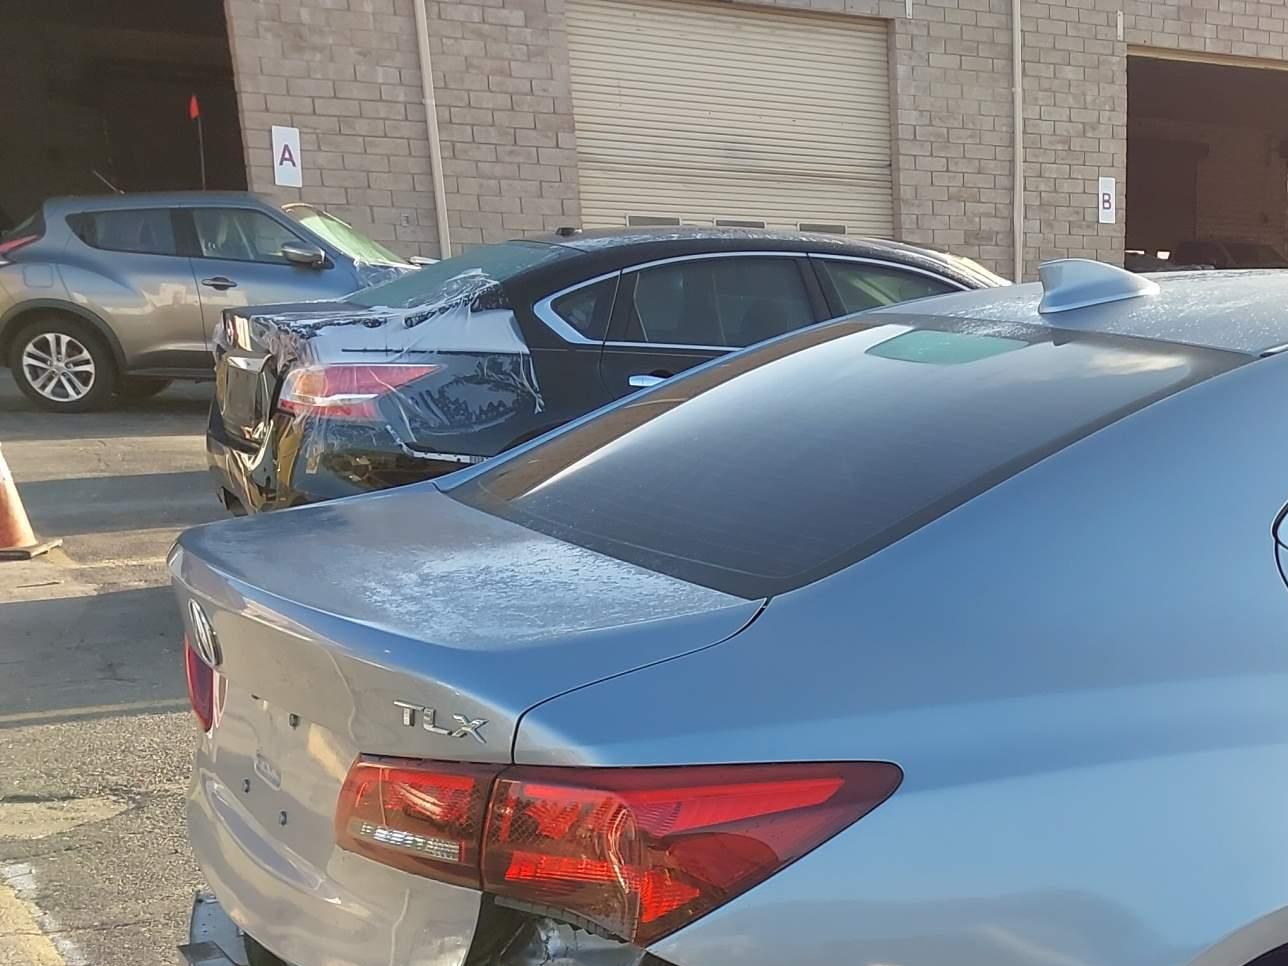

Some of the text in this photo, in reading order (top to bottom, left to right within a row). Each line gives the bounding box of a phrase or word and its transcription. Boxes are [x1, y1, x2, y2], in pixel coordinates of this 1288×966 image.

[279, 143, 296, 167] A
[1103, 193, 1111, 209] B
[393, 700, 489, 744] TLX
